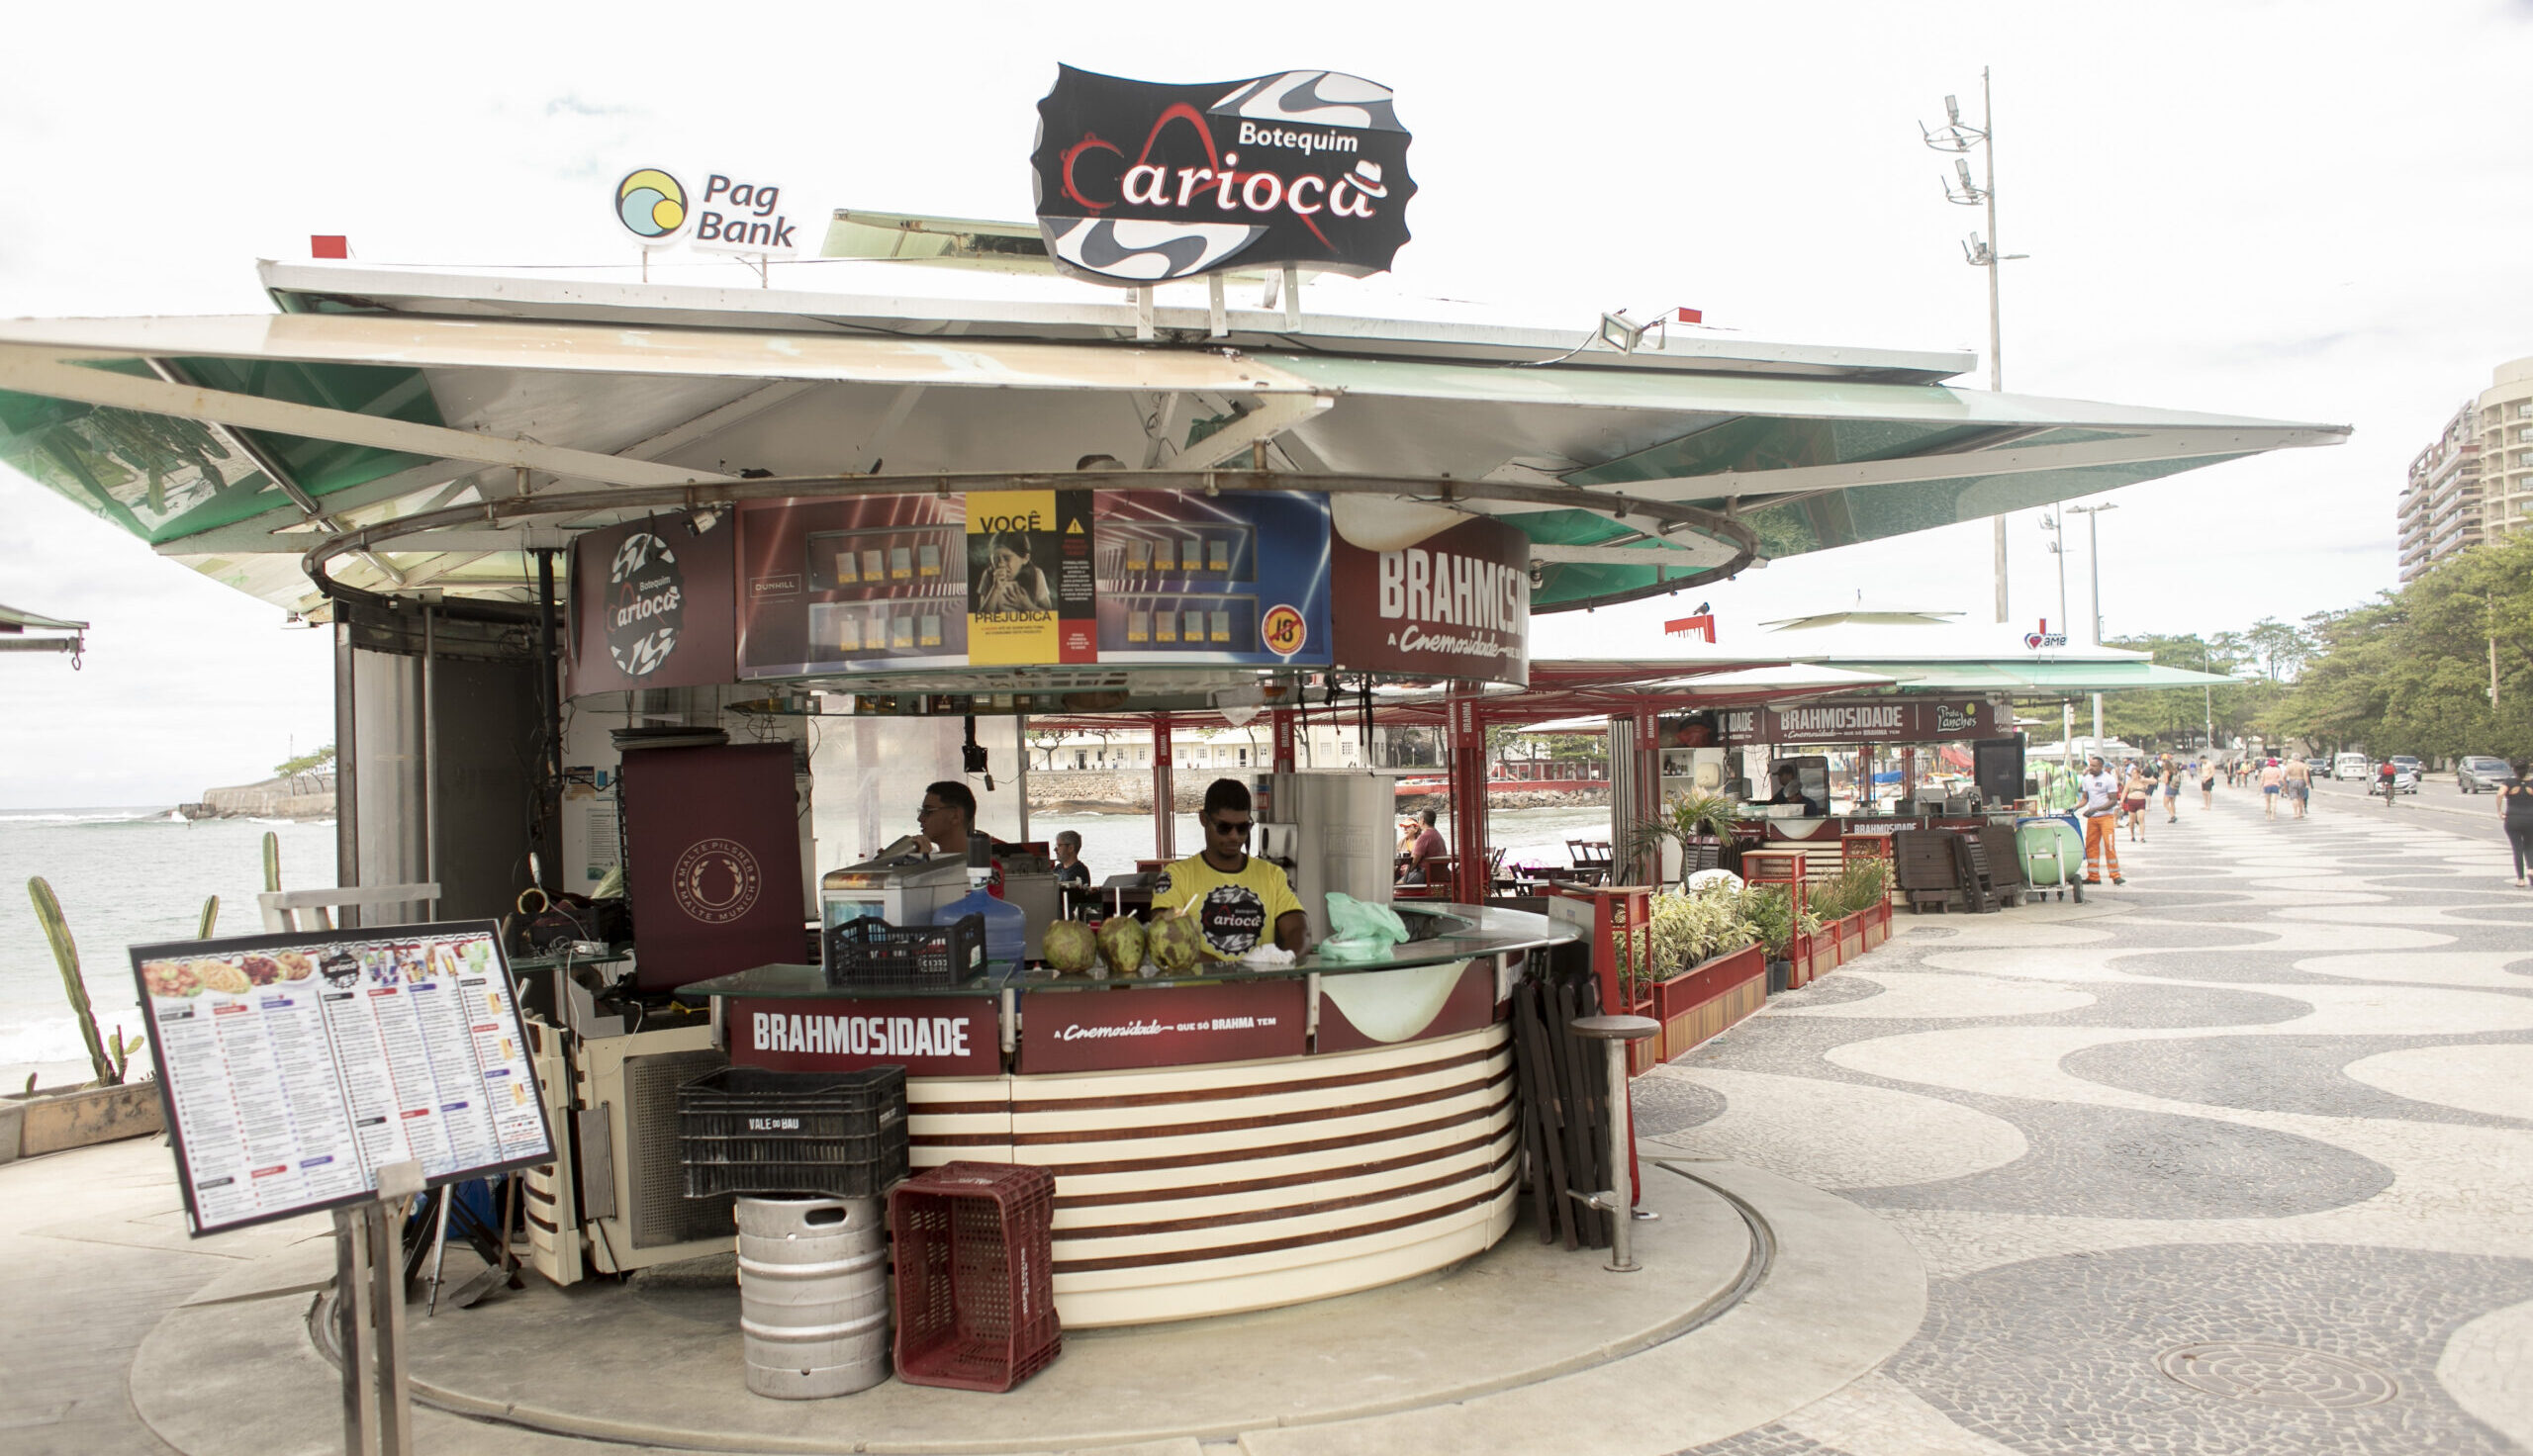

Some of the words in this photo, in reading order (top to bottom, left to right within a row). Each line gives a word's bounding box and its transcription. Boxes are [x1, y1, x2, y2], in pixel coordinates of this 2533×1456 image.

[1238, 121, 1359, 155] Botequim
[704, 173, 780, 217] Pag
[697, 211, 797, 247] Bank
[980, 510, 1042, 533] VOCÊ
[639, 576, 672, 592] Botequim
[755, 581, 796, 592] DUNHILL
[975, 610, 1052, 623] PREJUDICA
[1275, 617, 1293, 643] 18
[1387, 632, 1396, 646] A
[1462, 701, 1471, 733] BRAHMA
[1781, 705, 1904, 731] BRAHMOSIDADE
[1936, 712, 1977, 733] Lanches
[679, 844, 708, 876] MALTE
[712, 842, 754, 872] PILSNER
[681, 890, 712, 920] MALTE
[719, 885, 755, 920] MUNICH
[753, 1012, 972, 1056] BRAHMOSIDADE
[1176, 1023, 1195, 1032] QUE
[1197, 1019, 1210, 1031] SÓ
[1211, 1017, 1255, 1031] BRAHMA
[1257, 1017, 1276, 1027] TEM
[749, 1118, 772, 1131] VALE
